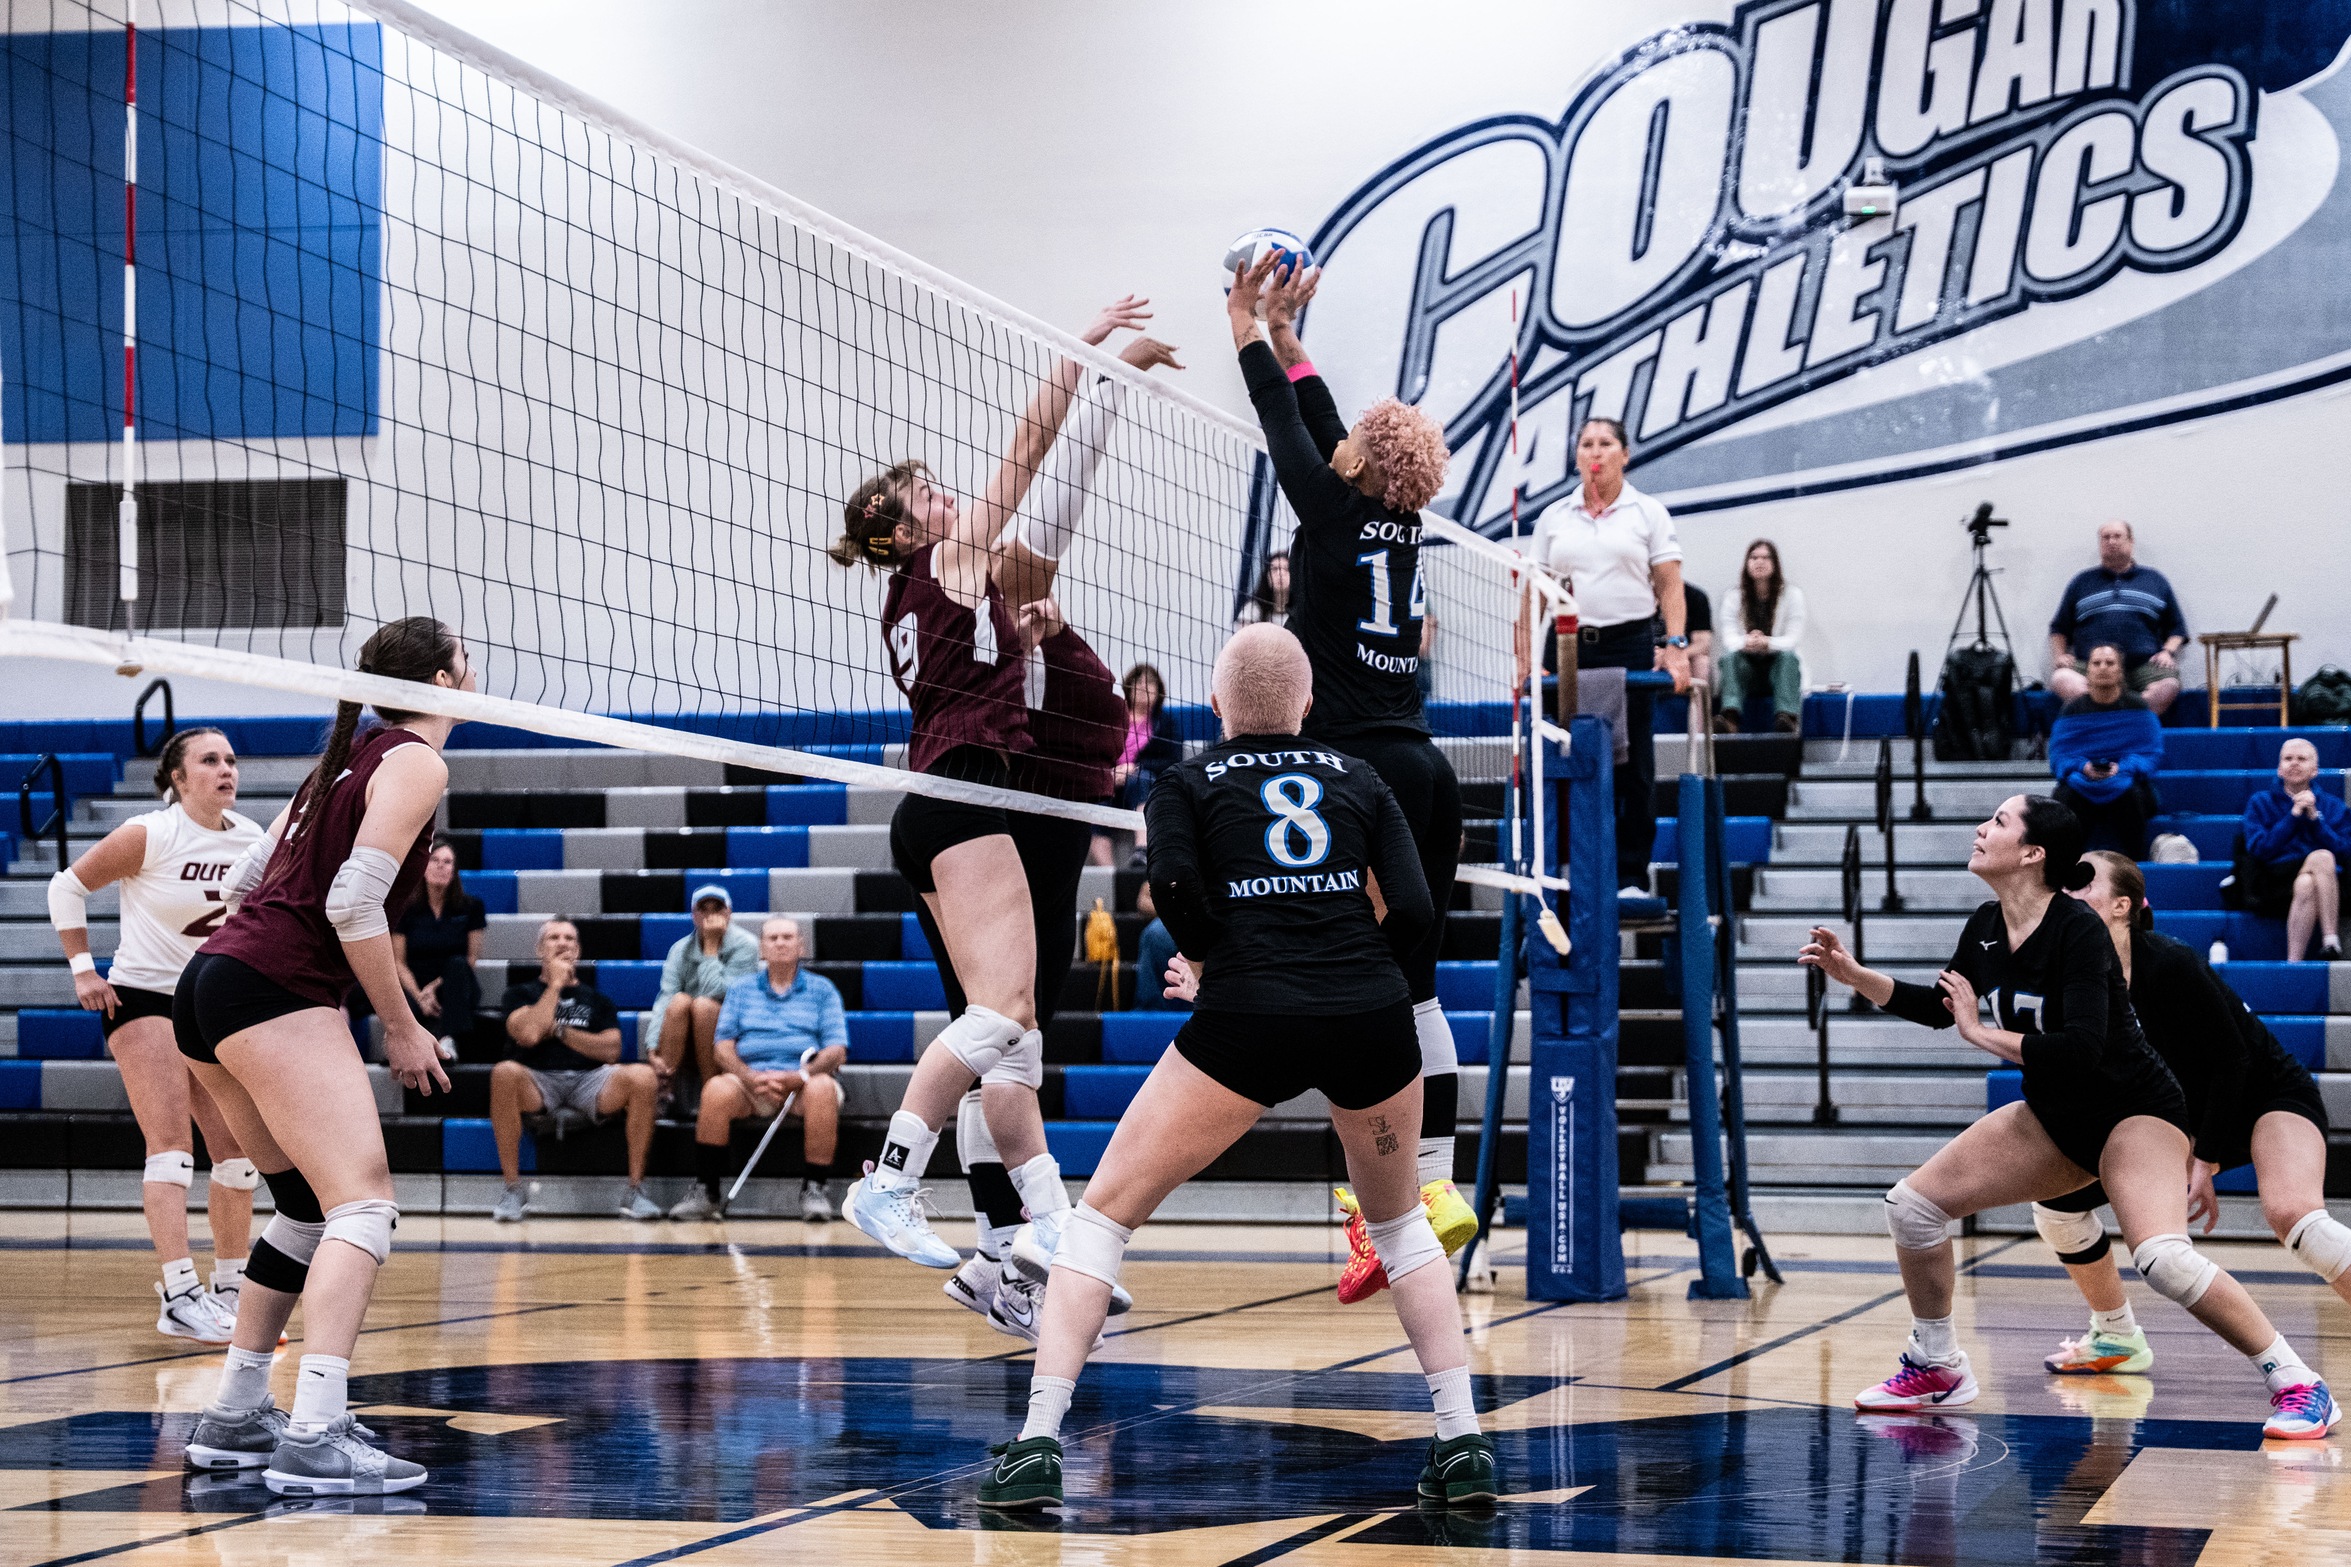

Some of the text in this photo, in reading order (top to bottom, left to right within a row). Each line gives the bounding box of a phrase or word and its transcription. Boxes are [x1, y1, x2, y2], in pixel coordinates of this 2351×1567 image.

[1464, 70, 2245, 535] ATHLETICS
[1359, 521, 1422, 545] SOUT
[889, 611, 919, 691] 9
[1357, 642, 1418, 673] MOUNT
[1205, 750, 1348, 782] SOUTH
[1260, 772, 1331, 868] 8
[1228, 870, 1359, 898] MOUNTAIN
